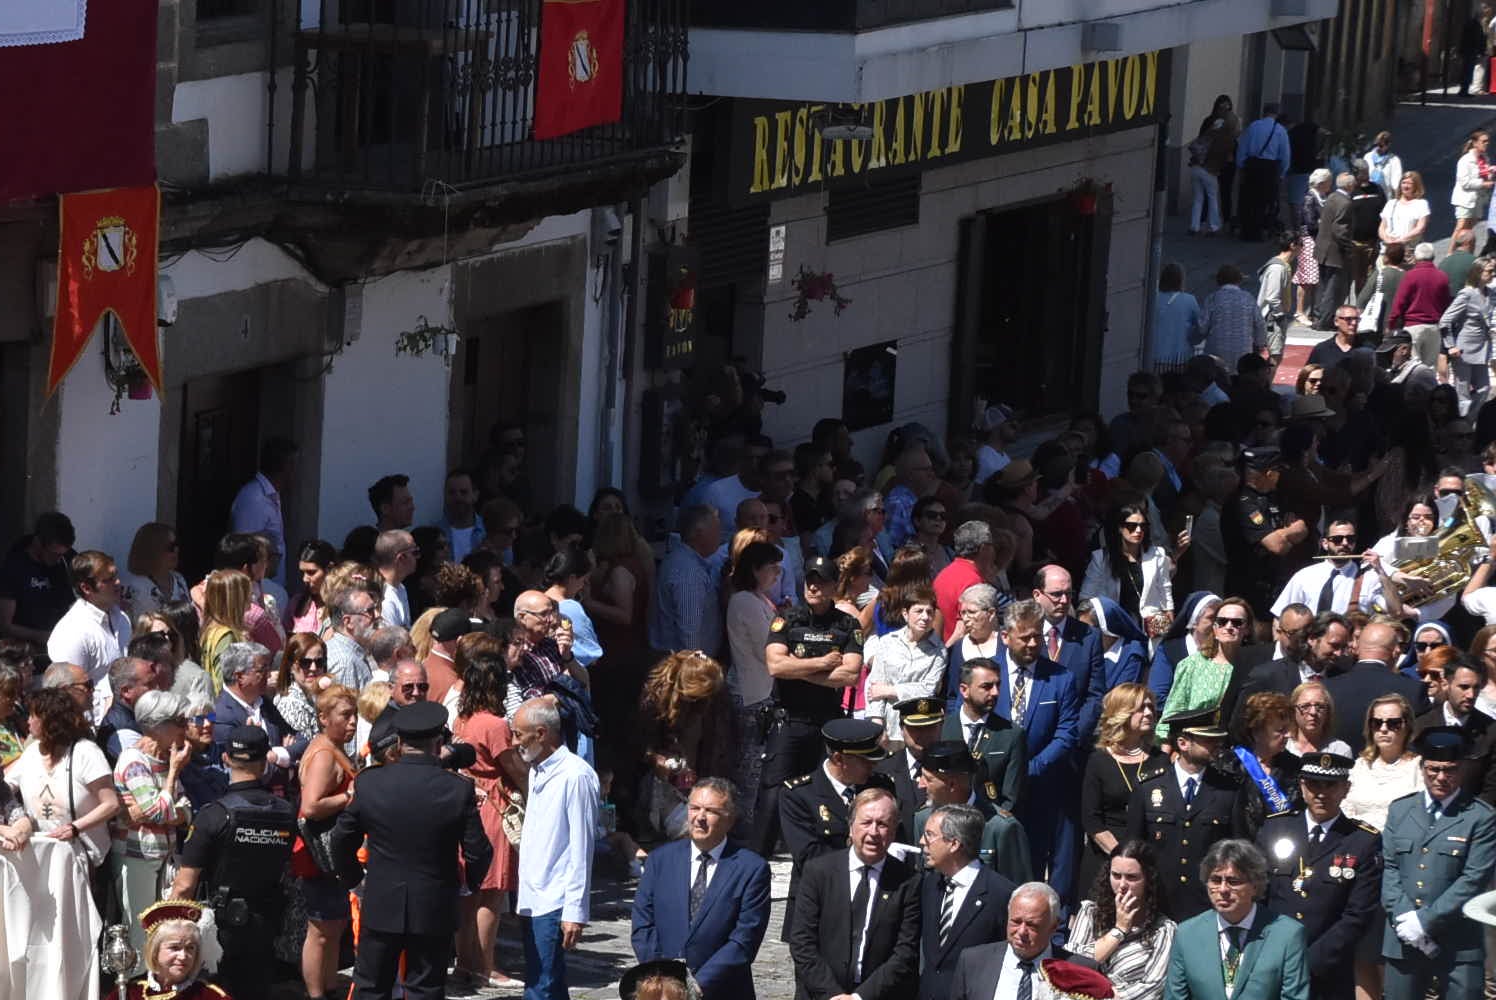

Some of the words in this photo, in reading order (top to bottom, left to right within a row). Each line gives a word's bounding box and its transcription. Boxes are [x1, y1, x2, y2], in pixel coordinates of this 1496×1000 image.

[750, 85, 965, 193] RESTAURANTE
[989, 69, 1057, 146] CASA
[1066, 50, 1160, 130] PAVON
[234, 835, 288, 846] NACIONAL
